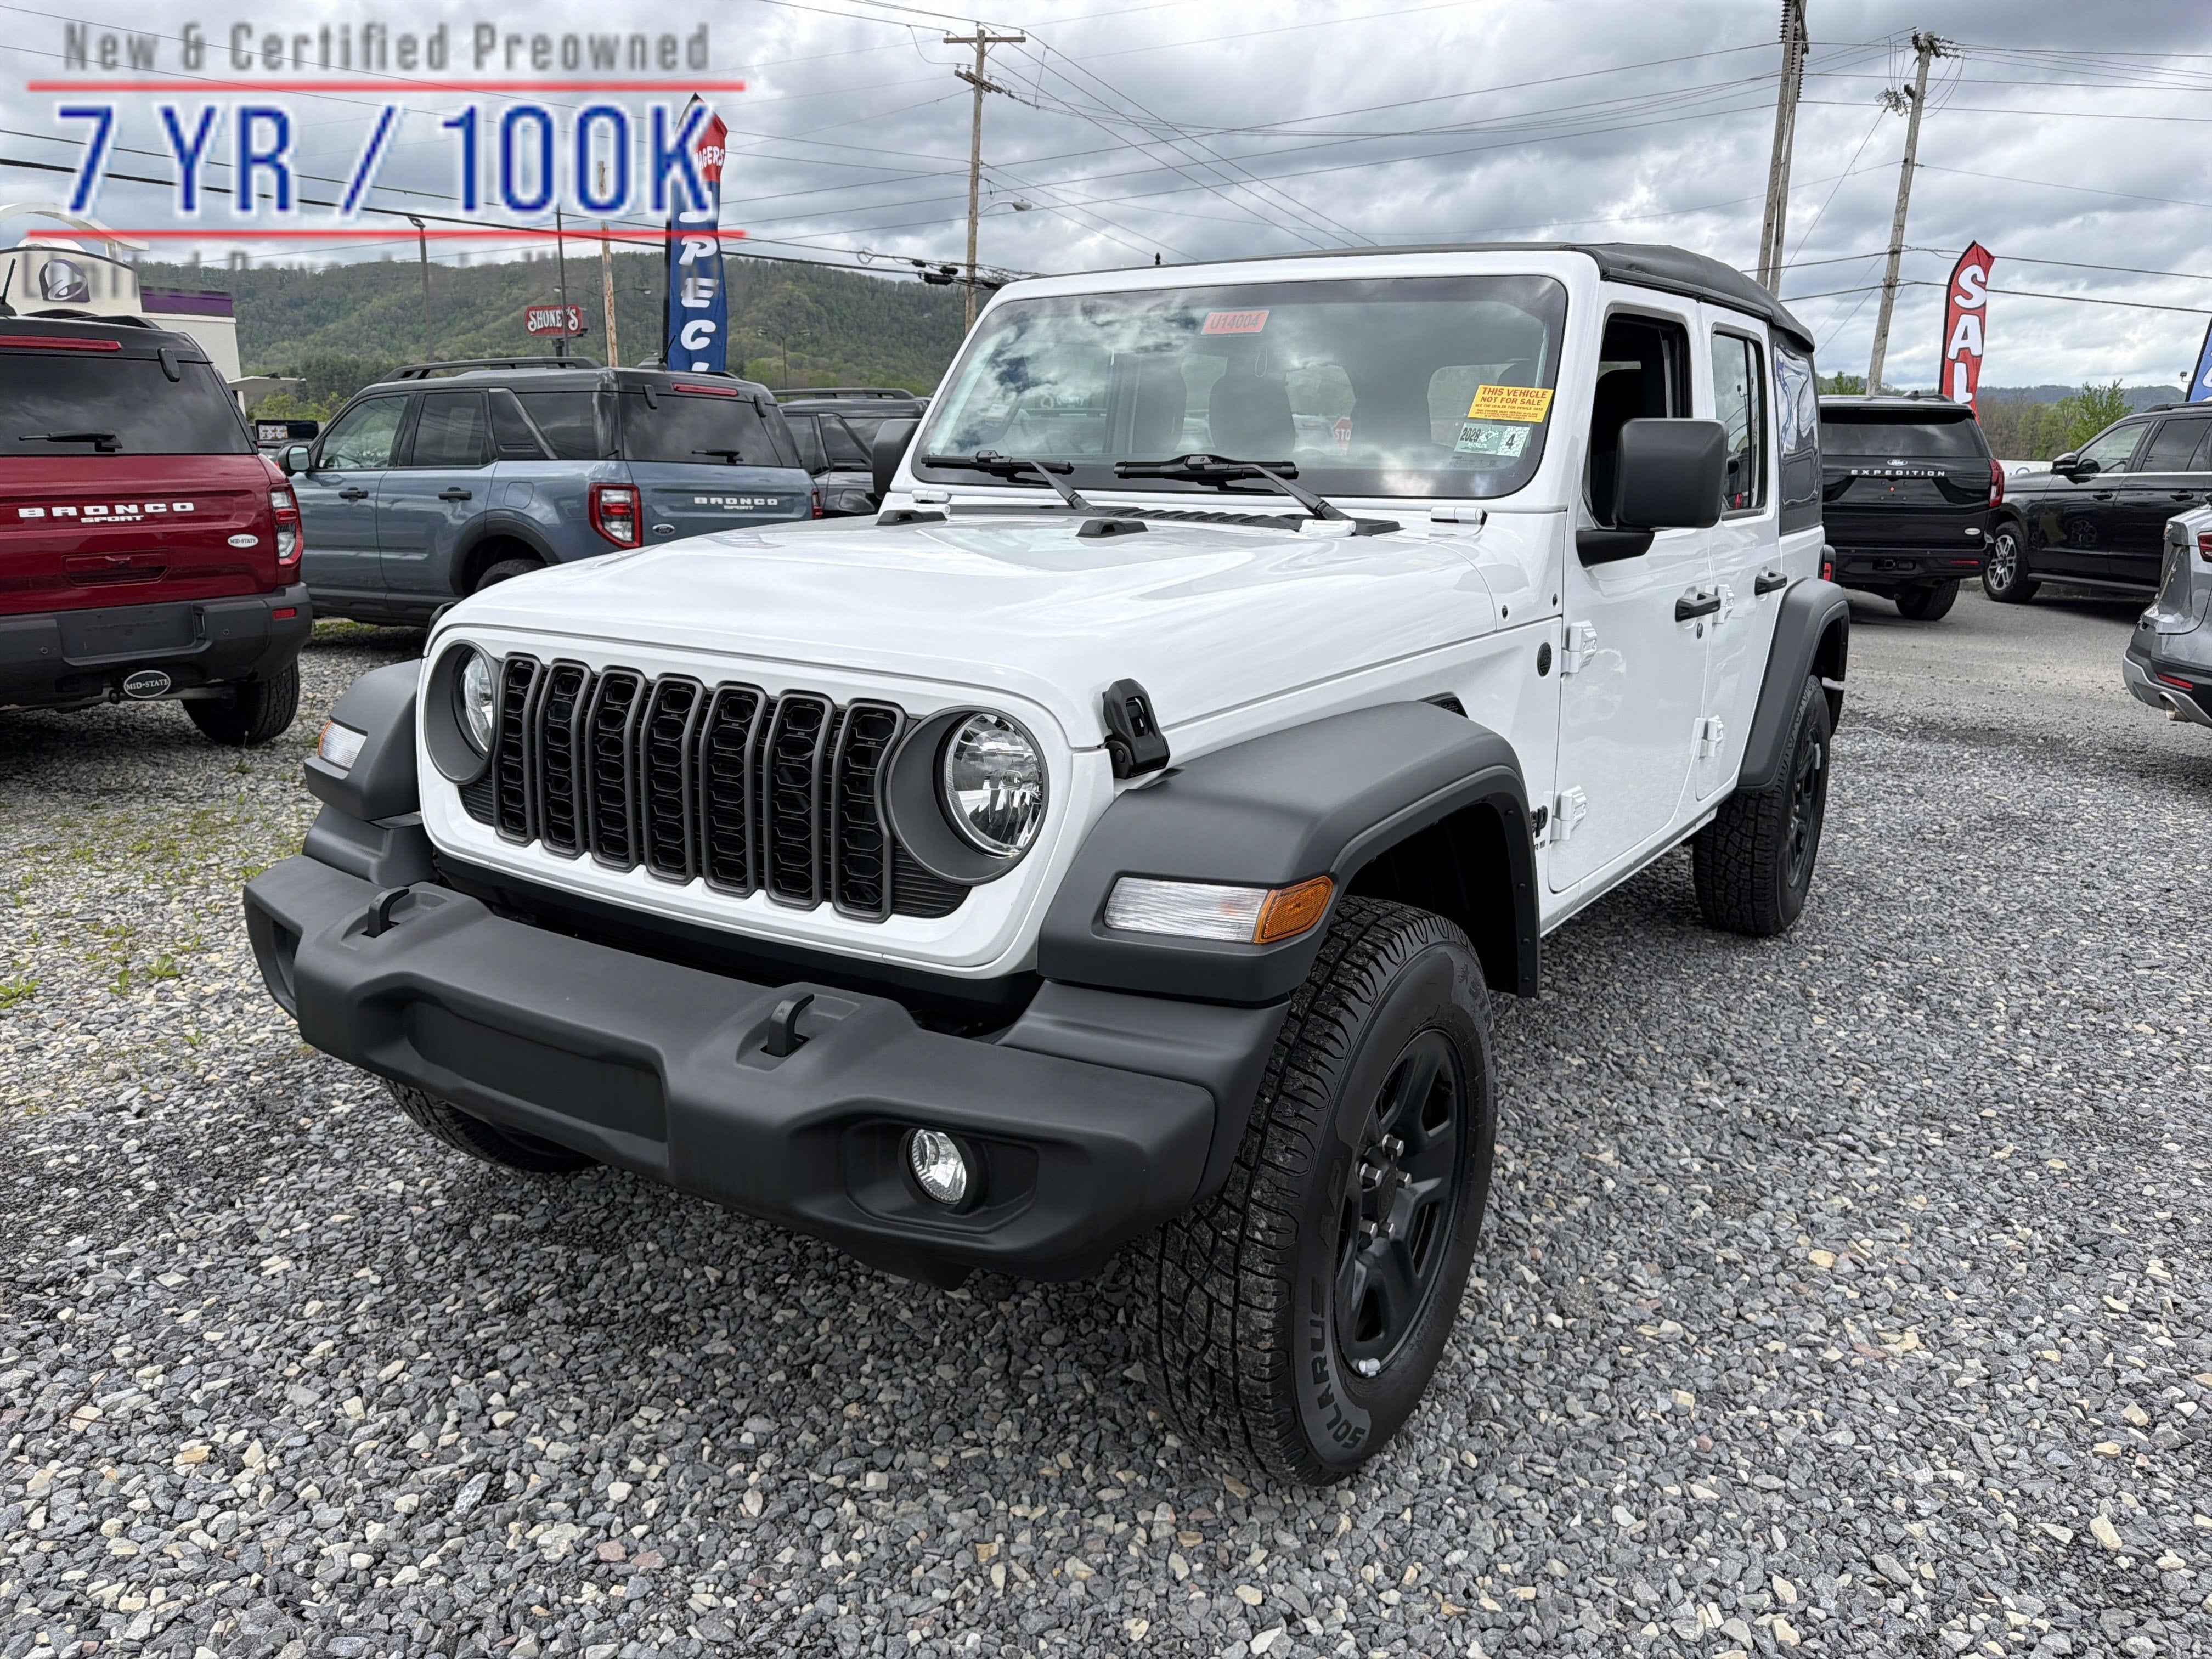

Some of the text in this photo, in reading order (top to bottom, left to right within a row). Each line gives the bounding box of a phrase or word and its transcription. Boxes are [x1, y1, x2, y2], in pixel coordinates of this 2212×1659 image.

[695, 146, 725, 170] AGERS
[1210, 314, 1260, 329] U14004
[1947, 264, 1987, 404] SAL
[1482, 387, 1549, 399] THIS VEHICLE
[1335, 428, 1352, 441] STO
[1459, 427, 1481, 442] 2028
[1505, 433, 1516, 449] 4
[694, 497, 778, 506] BRONCO
[18, 502, 194, 518] BRONCO
[80, 514, 144, 523] SPORT
[126, 678, 169, 691] MID-STATE
